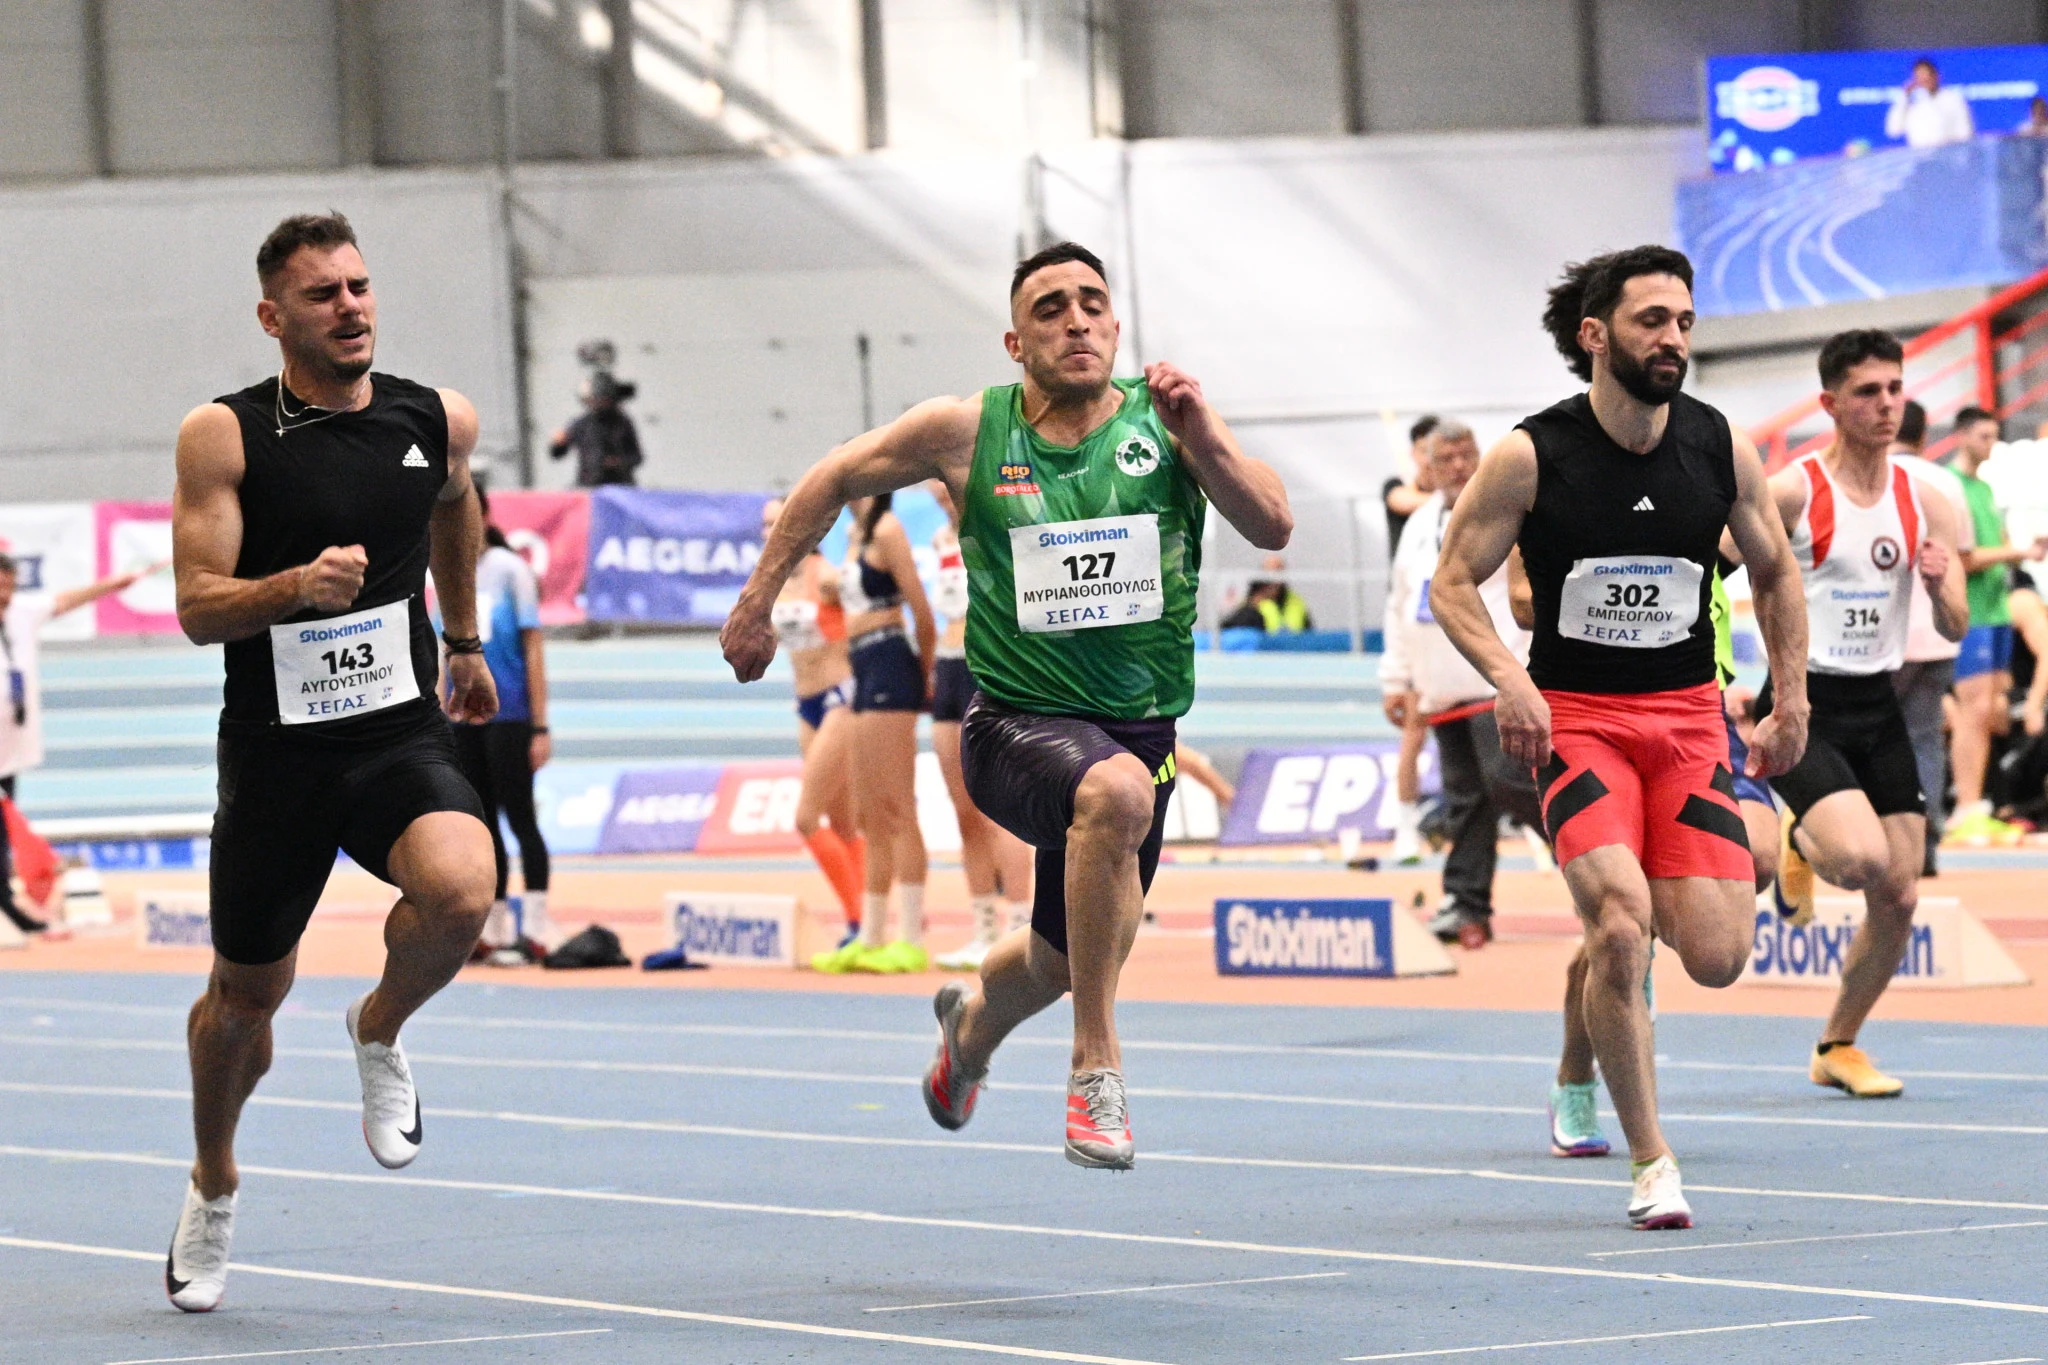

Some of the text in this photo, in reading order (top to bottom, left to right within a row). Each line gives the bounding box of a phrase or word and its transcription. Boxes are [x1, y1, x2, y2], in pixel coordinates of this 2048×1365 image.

[1001, 466, 1030, 476] RIO
[1039, 528, 1128, 547] Stoiximan
[1062, 552, 1116, 581] 127
[1594, 563, 1673, 576] Stoiximan
[1024, 579, 1156, 603] ΜΥΡΙΑΝΘΟΠΟΥΛΟΣ
[1604, 584, 1660, 607] 302
[1046, 606, 1109, 624] ΣΕΓΑΣ
[1587, 606, 1673, 622] ΕΜΠΕΟΓΛΟΥ
[1844, 608, 1880, 627] 314
[300, 618, 383, 643] Stoiximan
[1583, 624, 1642, 641] ΣΕΓΑΣ
[320, 643, 375, 674] 143
[301, 664, 393, 694] ΑΥΓΟΥΣΤΙΝΟΥ
[307, 694, 367, 715] ΣΕΓΑΣ
[1227, 904, 1378, 969] Stoiximan
[1754, 910, 1934, 976] Stoixian
